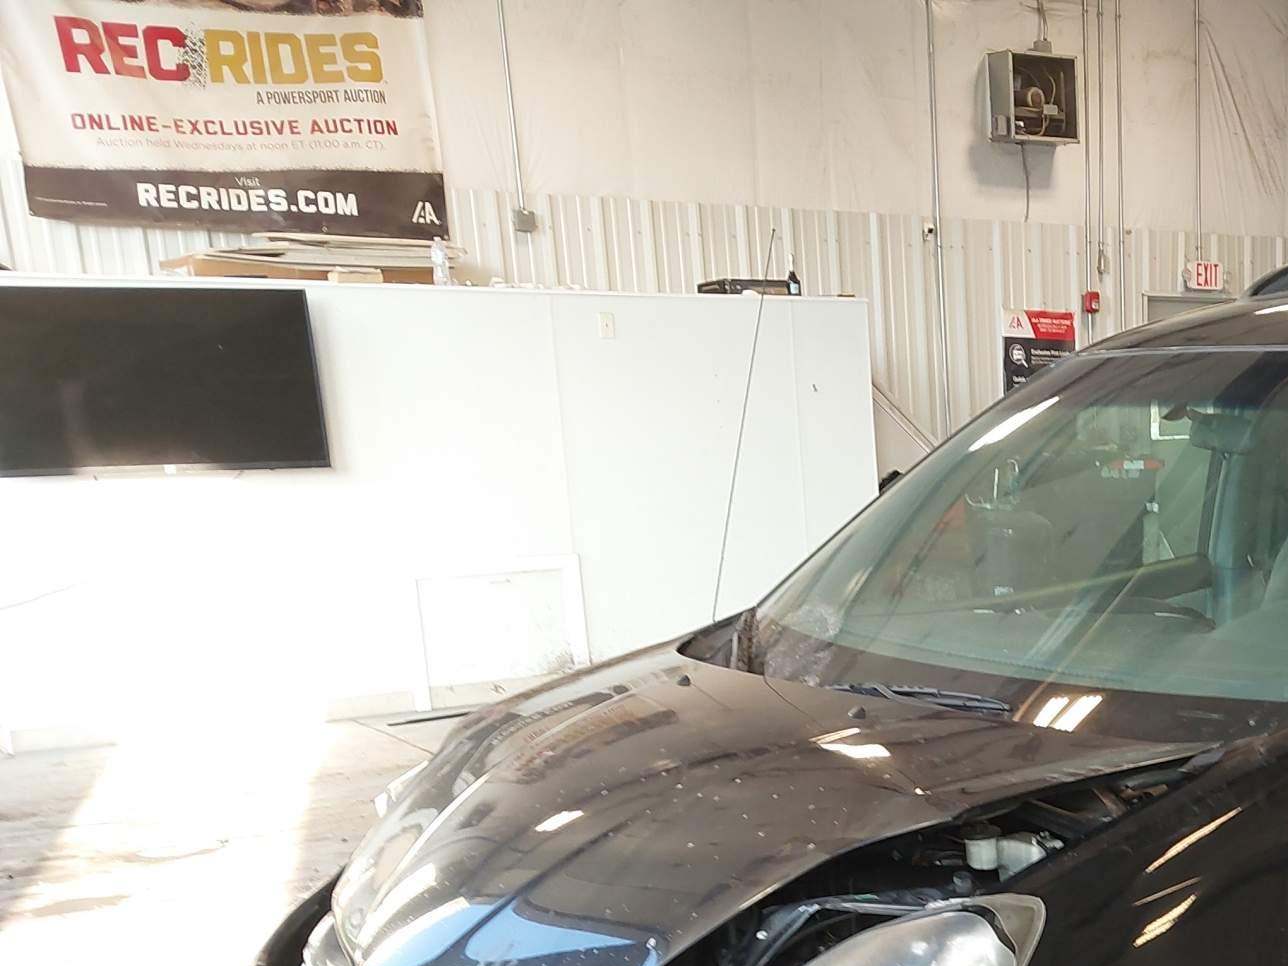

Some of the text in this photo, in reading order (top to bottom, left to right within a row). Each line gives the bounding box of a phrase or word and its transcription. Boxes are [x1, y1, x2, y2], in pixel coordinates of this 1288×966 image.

[54, 16, 384, 84] REC RIDES
[256, 88, 386, 105] A POWERSPORT AUCTION
[71, 113, 399, 136] ONLINE-EXCLUSIVE AUCTION
[96, 137, 143, 149] Auction
[146, 138, 171, 149] held
[174, 139, 245, 152] Wednesdays
[247, 143, 257, 151] at
[260, 142, 289, 150] noon
[234, 176, 260, 187] Visit
[136, 182, 359, 216] RECRIDES.COM
[1196, 263, 1220, 287] EXIT
